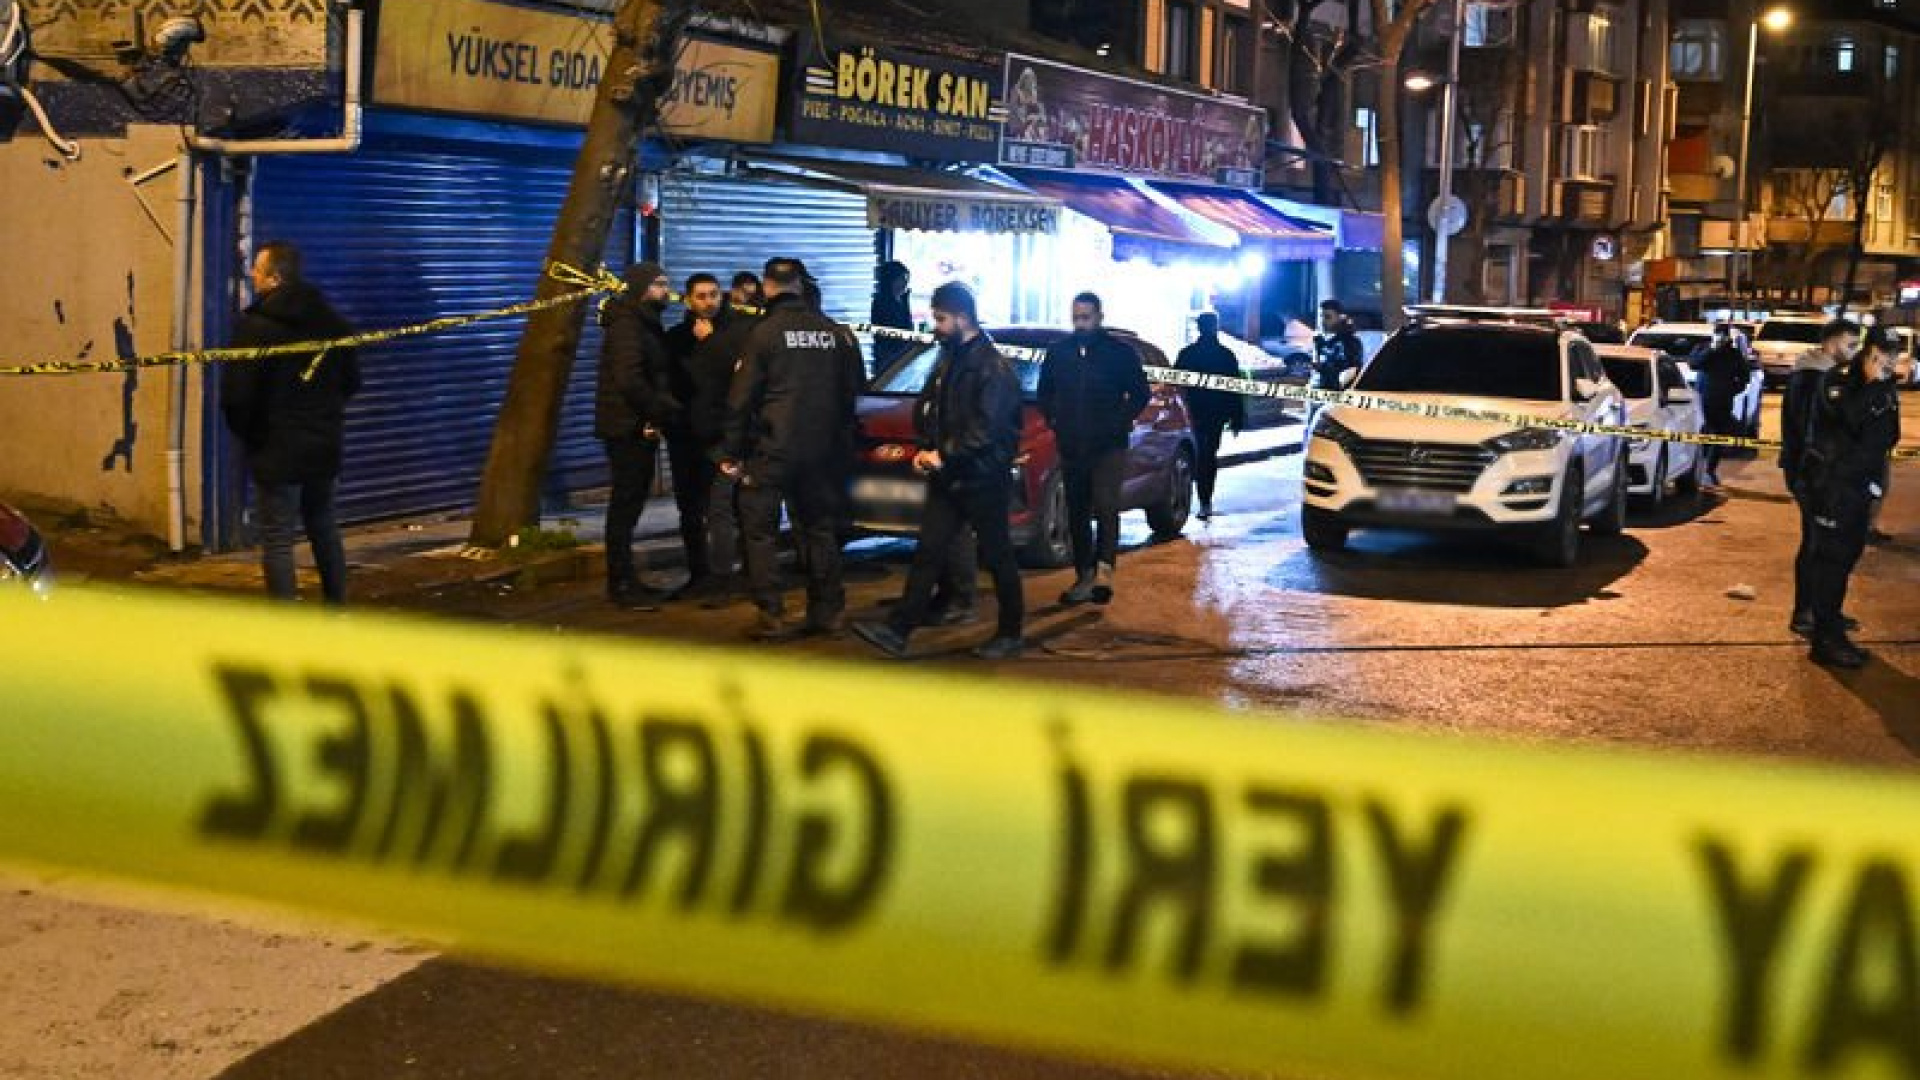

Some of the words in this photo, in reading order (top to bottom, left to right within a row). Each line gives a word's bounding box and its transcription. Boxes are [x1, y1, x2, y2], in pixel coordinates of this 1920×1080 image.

[447, 26, 543, 86] YÜKSEL
[551, 49, 601, 91] GIDA
[837, 47, 930, 110] BÖREK
[936, 72, 989, 118] SAN
